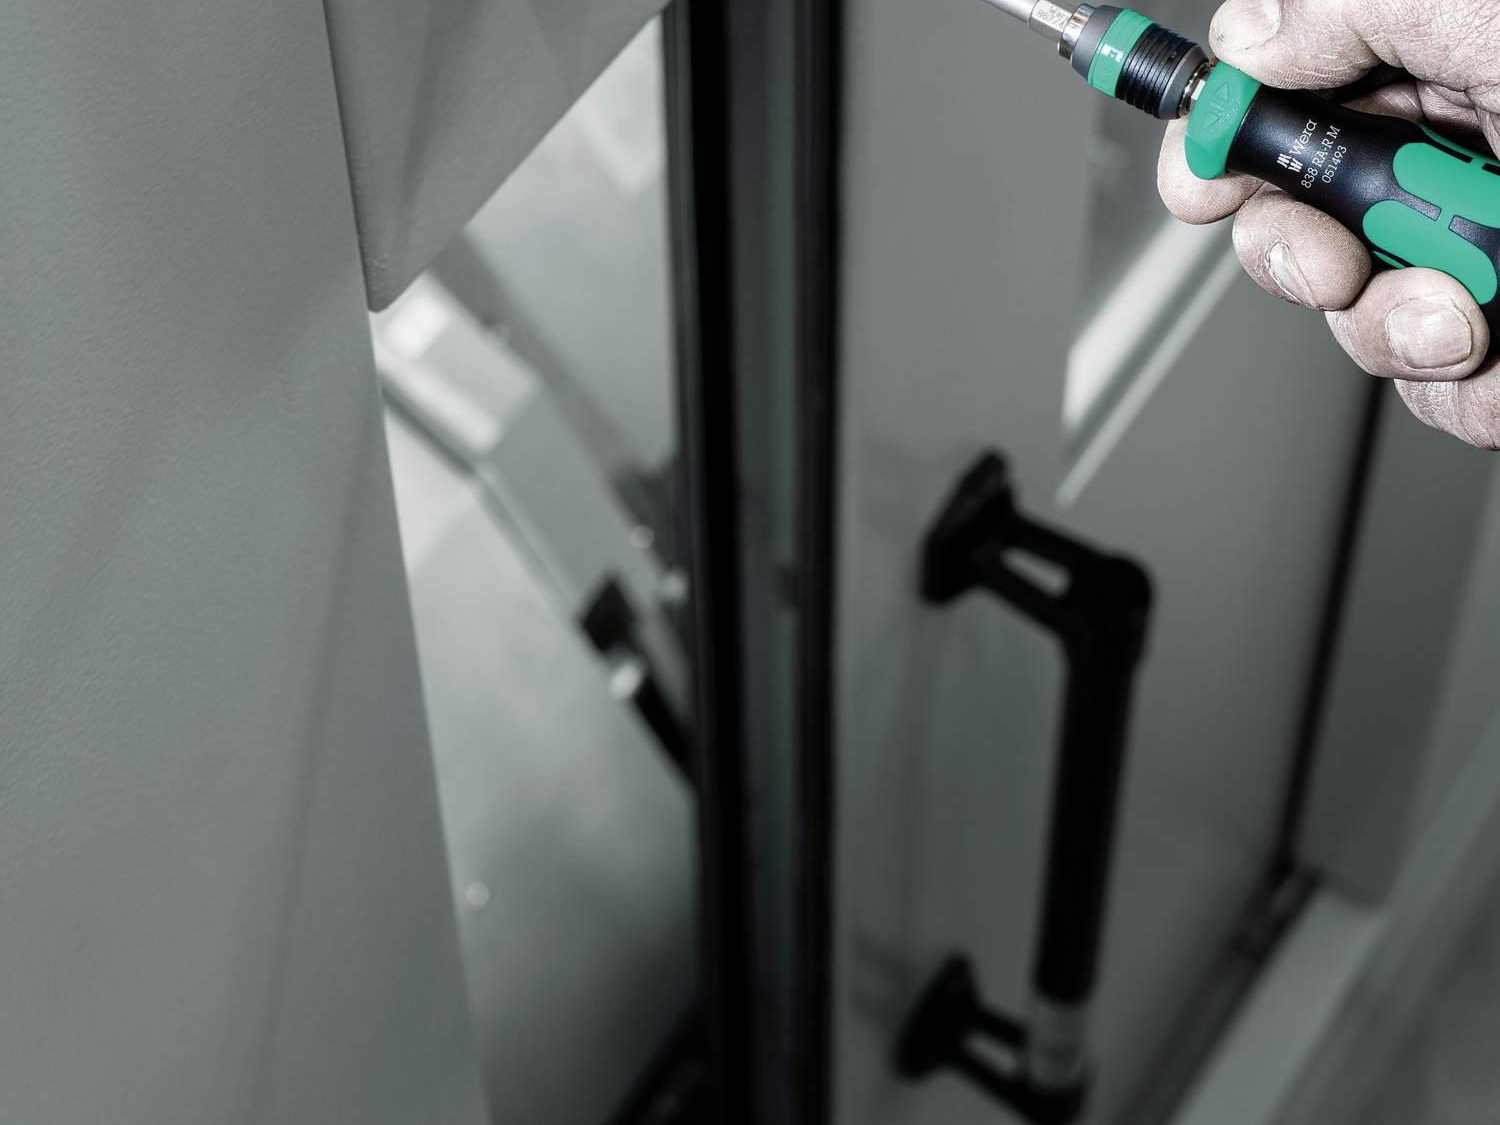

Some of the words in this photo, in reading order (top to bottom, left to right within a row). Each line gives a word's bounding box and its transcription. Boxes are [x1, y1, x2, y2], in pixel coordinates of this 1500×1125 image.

[1289, 119, 1317, 155] Wera
[1301, 167, 1318, 189] 838
[1312, 138, 1334, 167] RA-R
[1326, 125, 1341, 139] M
[1322, 145, 1347, 184] 051493
